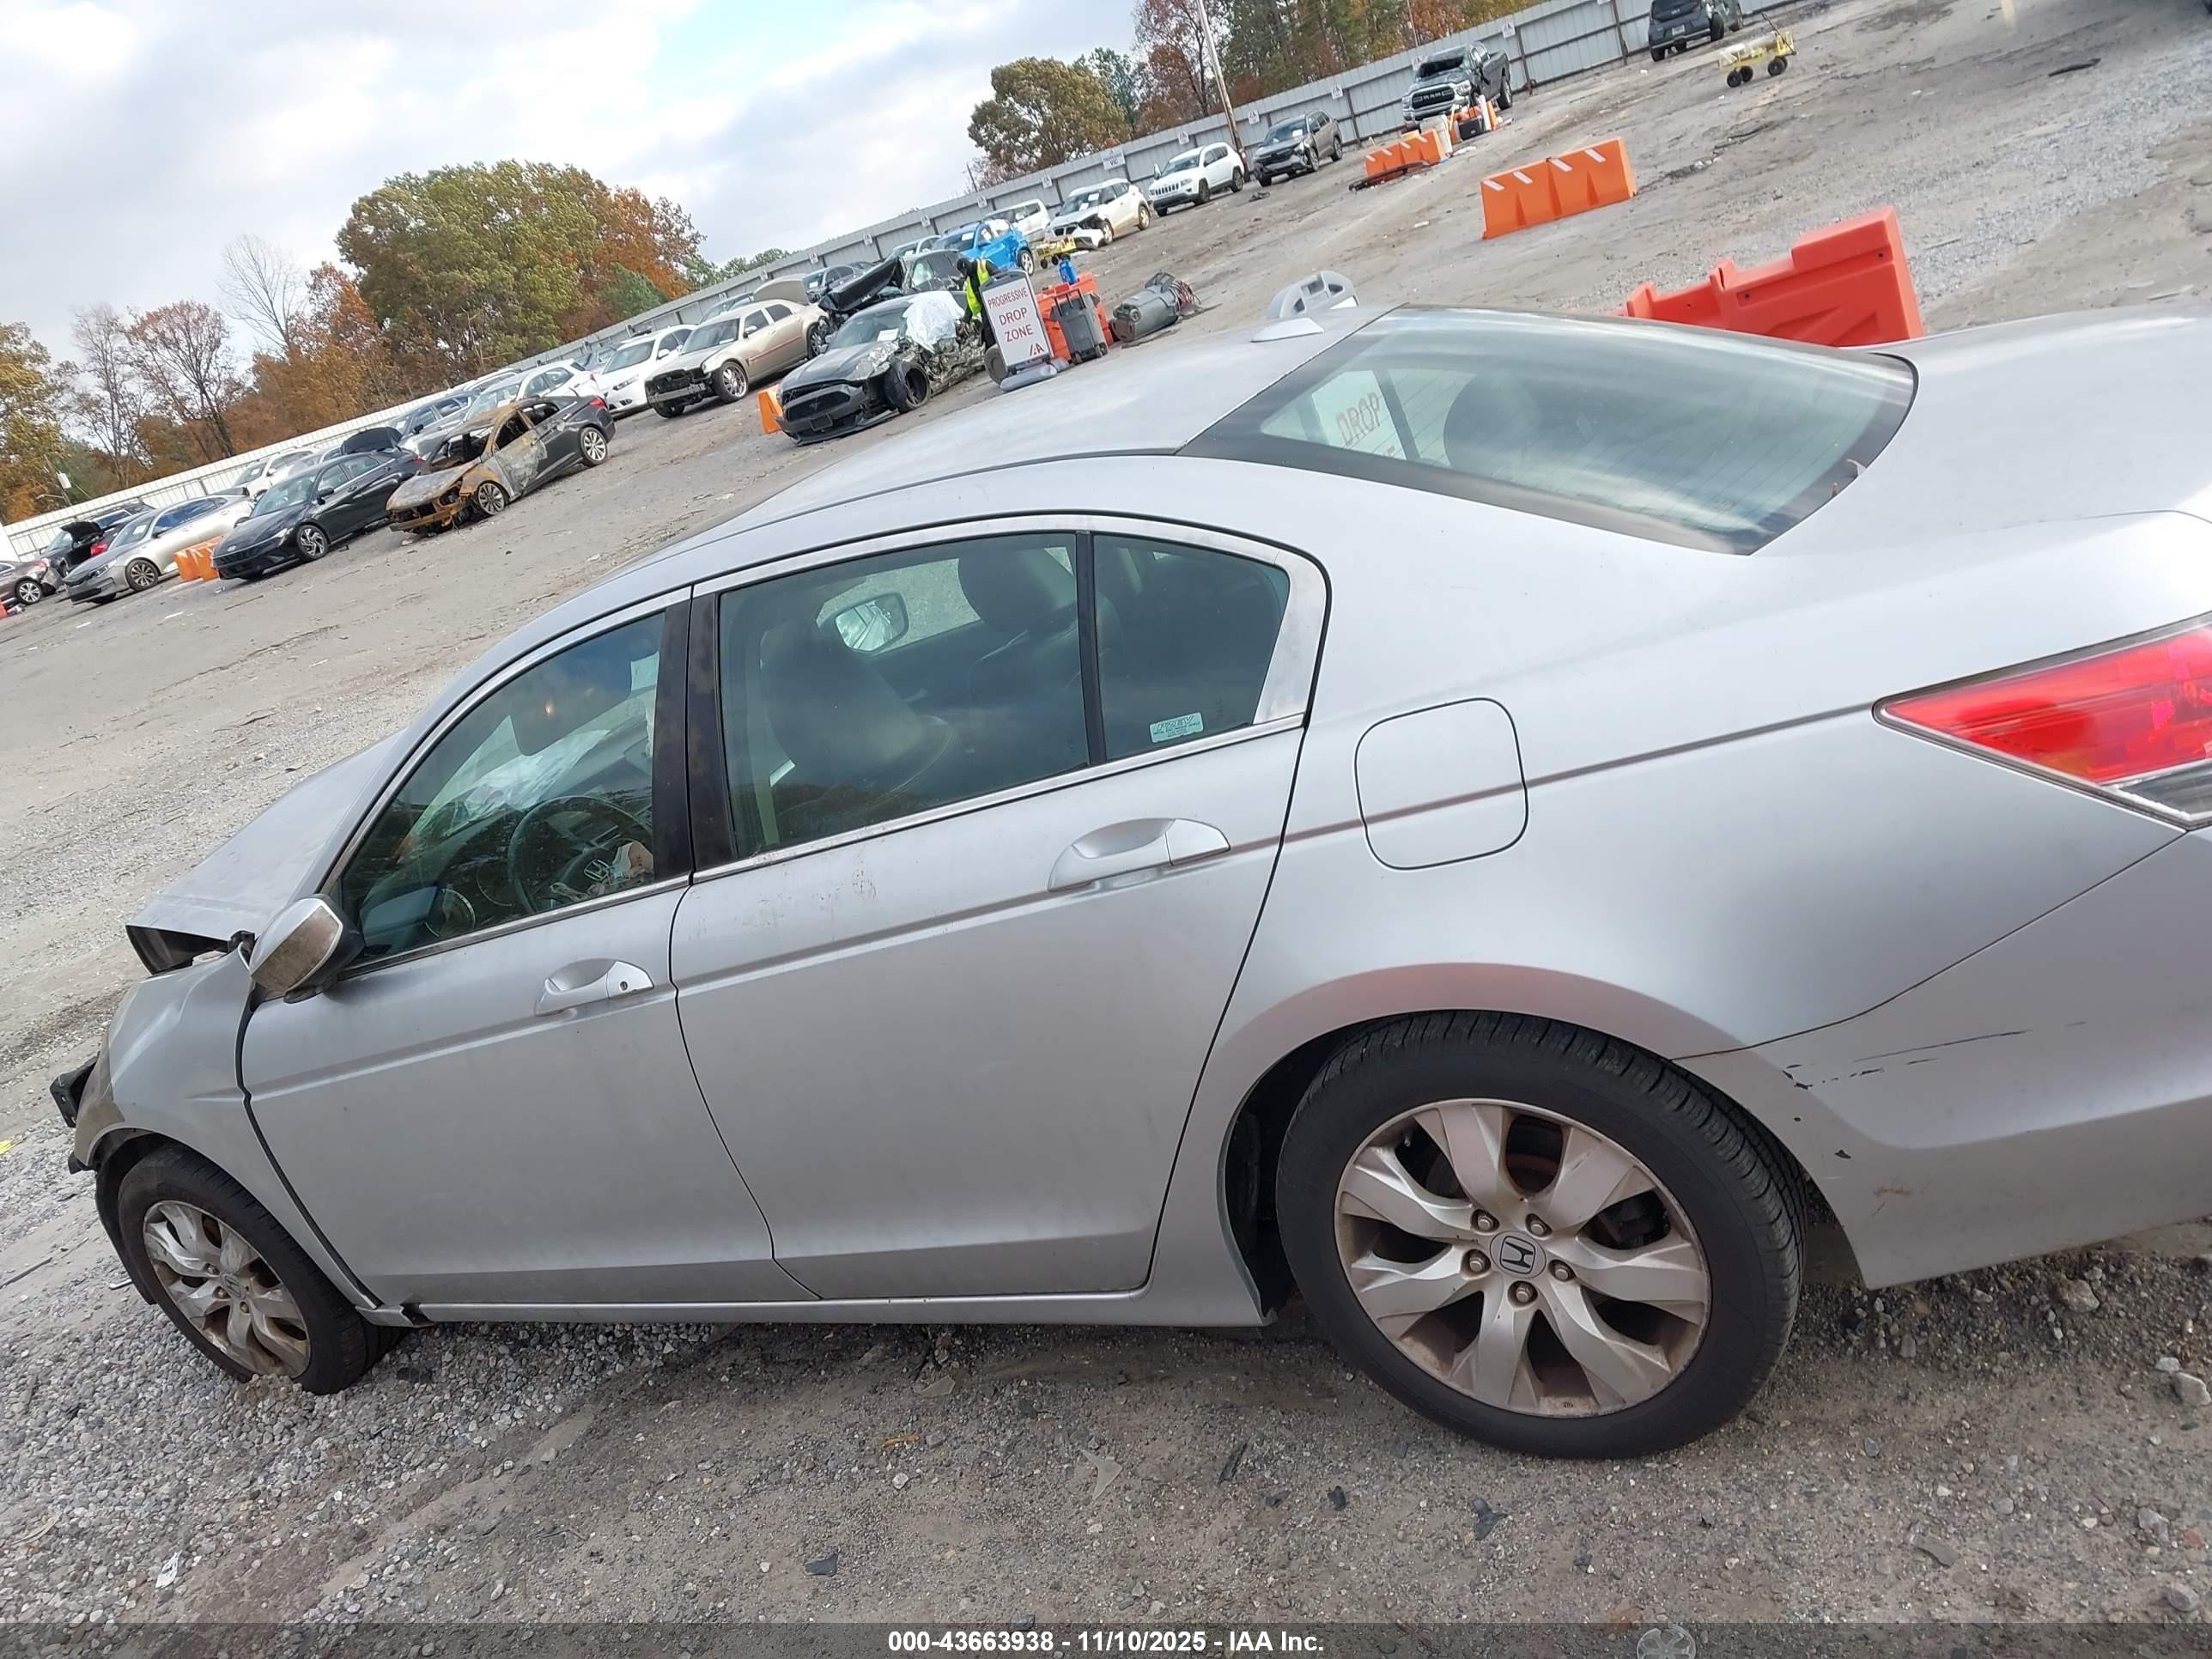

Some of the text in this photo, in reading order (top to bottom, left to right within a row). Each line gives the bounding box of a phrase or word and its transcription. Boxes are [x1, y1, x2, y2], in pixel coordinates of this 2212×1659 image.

[988, 287, 1028, 309] PROGRESSIVE
[999, 307, 1028, 325] DROP
[1005, 324, 1033, 343] ZONE
[1335, 392, 1381, 447] DROP
